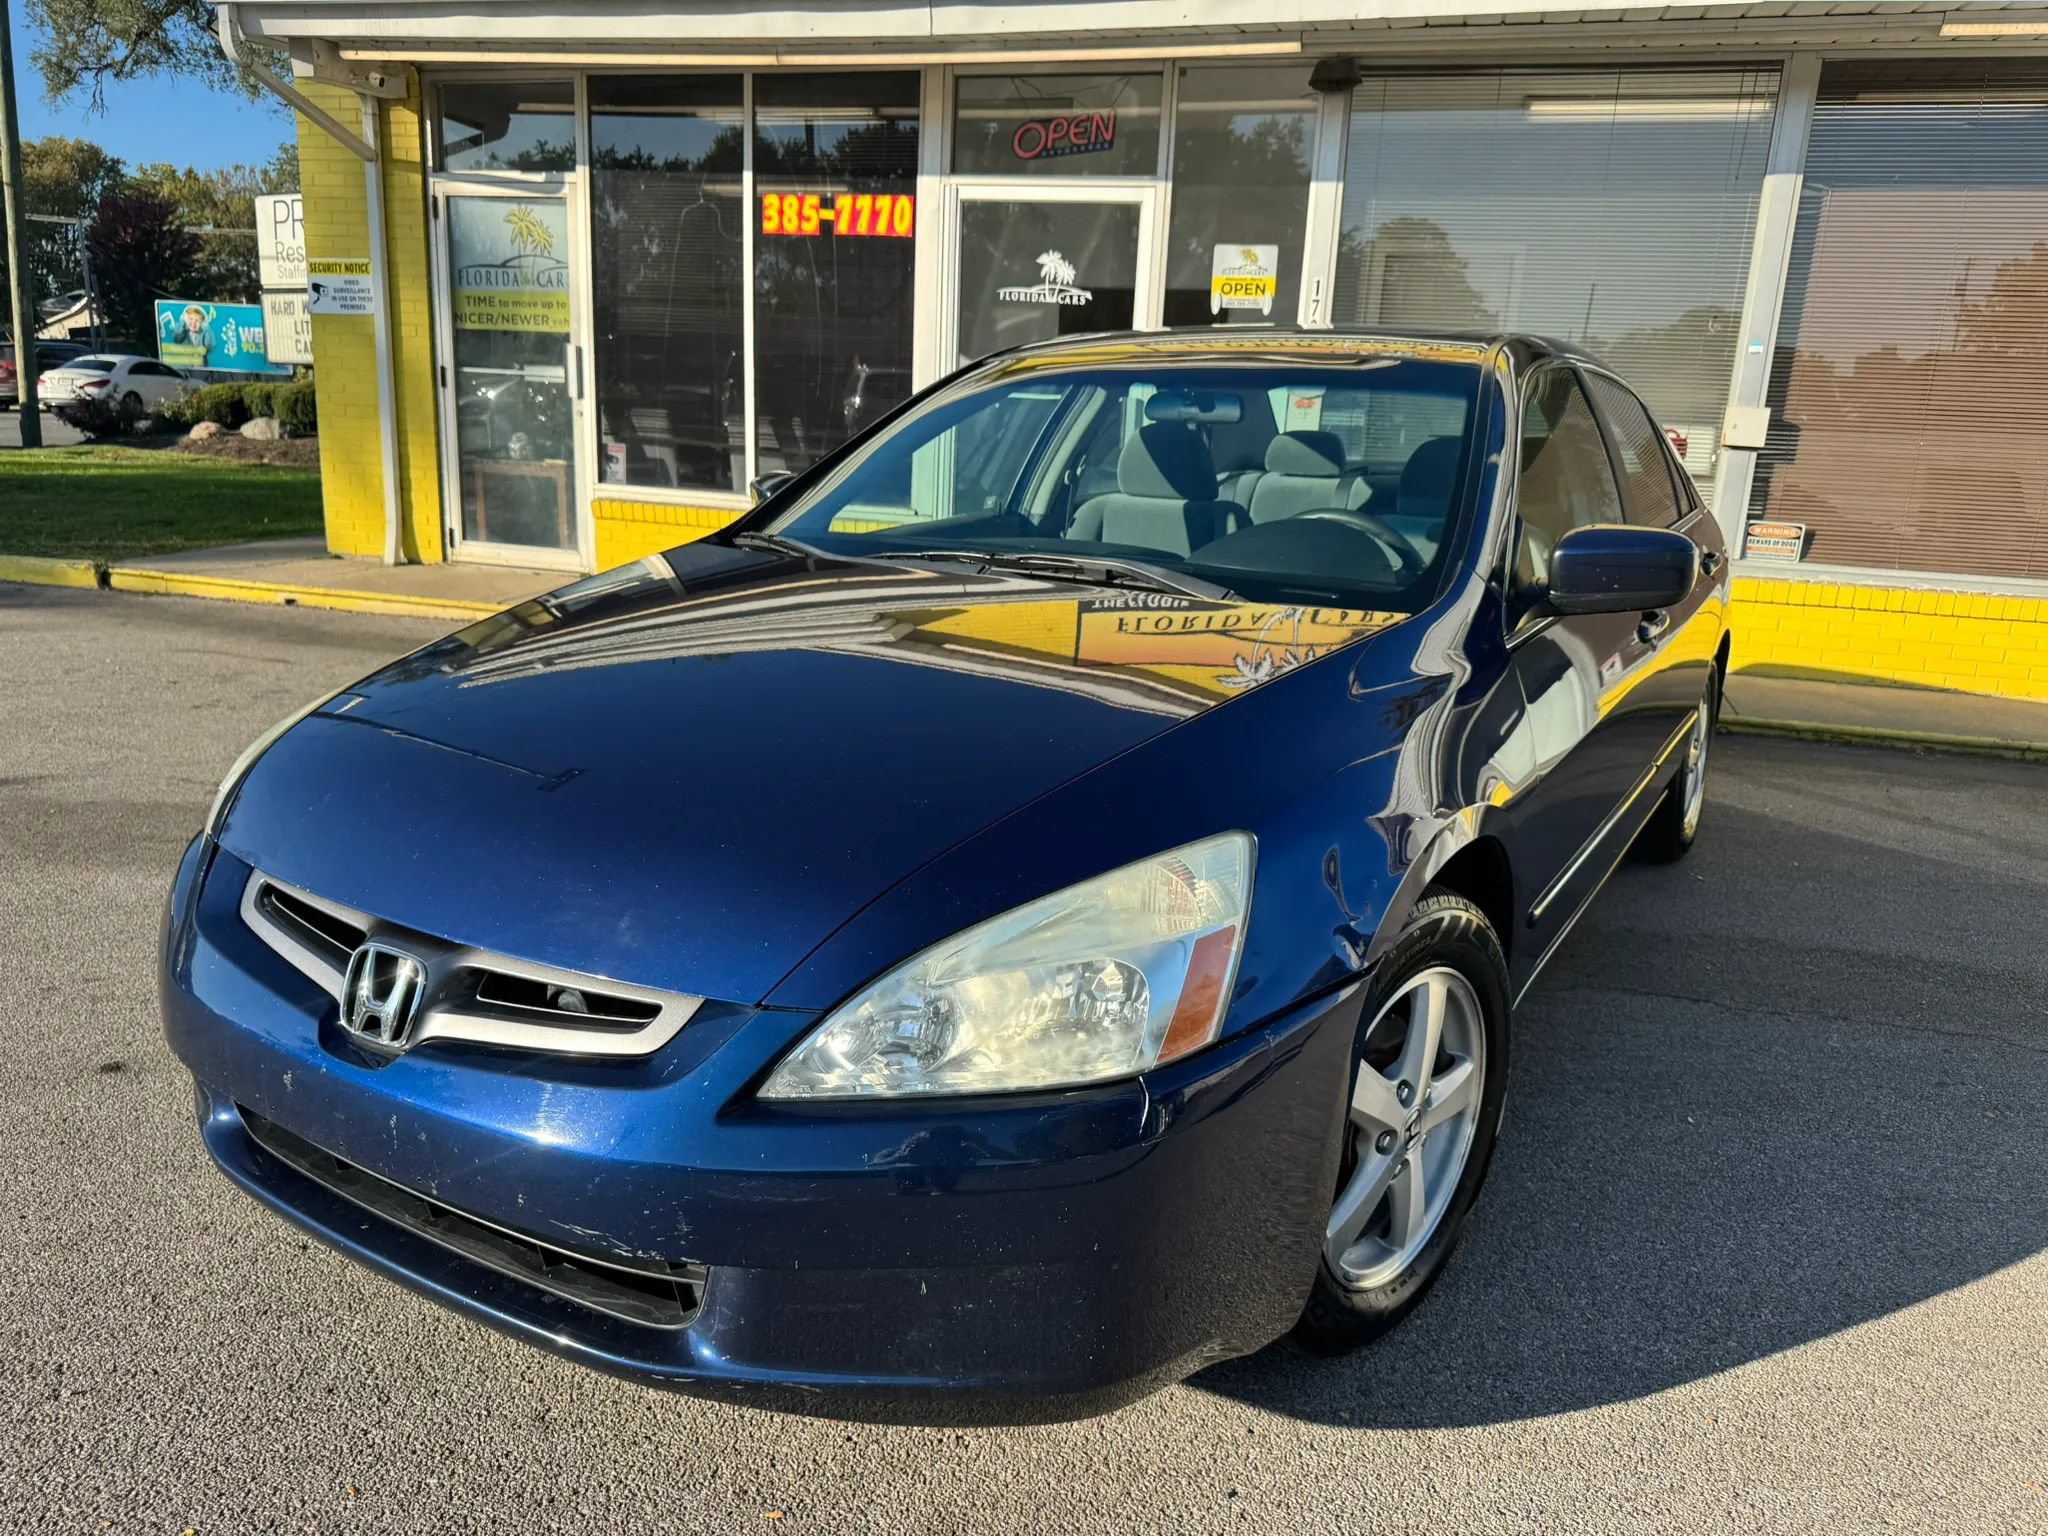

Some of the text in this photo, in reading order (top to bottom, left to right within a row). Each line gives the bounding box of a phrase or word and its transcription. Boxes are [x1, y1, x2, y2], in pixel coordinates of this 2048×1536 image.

[1013, 111, 1115, 159] OPEN
[763, 194, 912, 234] 385-7770
[309, 262, 370, 274] SECURITY NOTICE
[457, 269, 570, 288] FLORIDA CAR
[1221, 282, 1266, 296] OPEN
[464, 295, 567, 310] TIME to move up to
[999, 290, 1086, 306] FLORIDA CARS
[1310, 279, 1321, 325] 17
[270, 301, 296, 316] HARD
